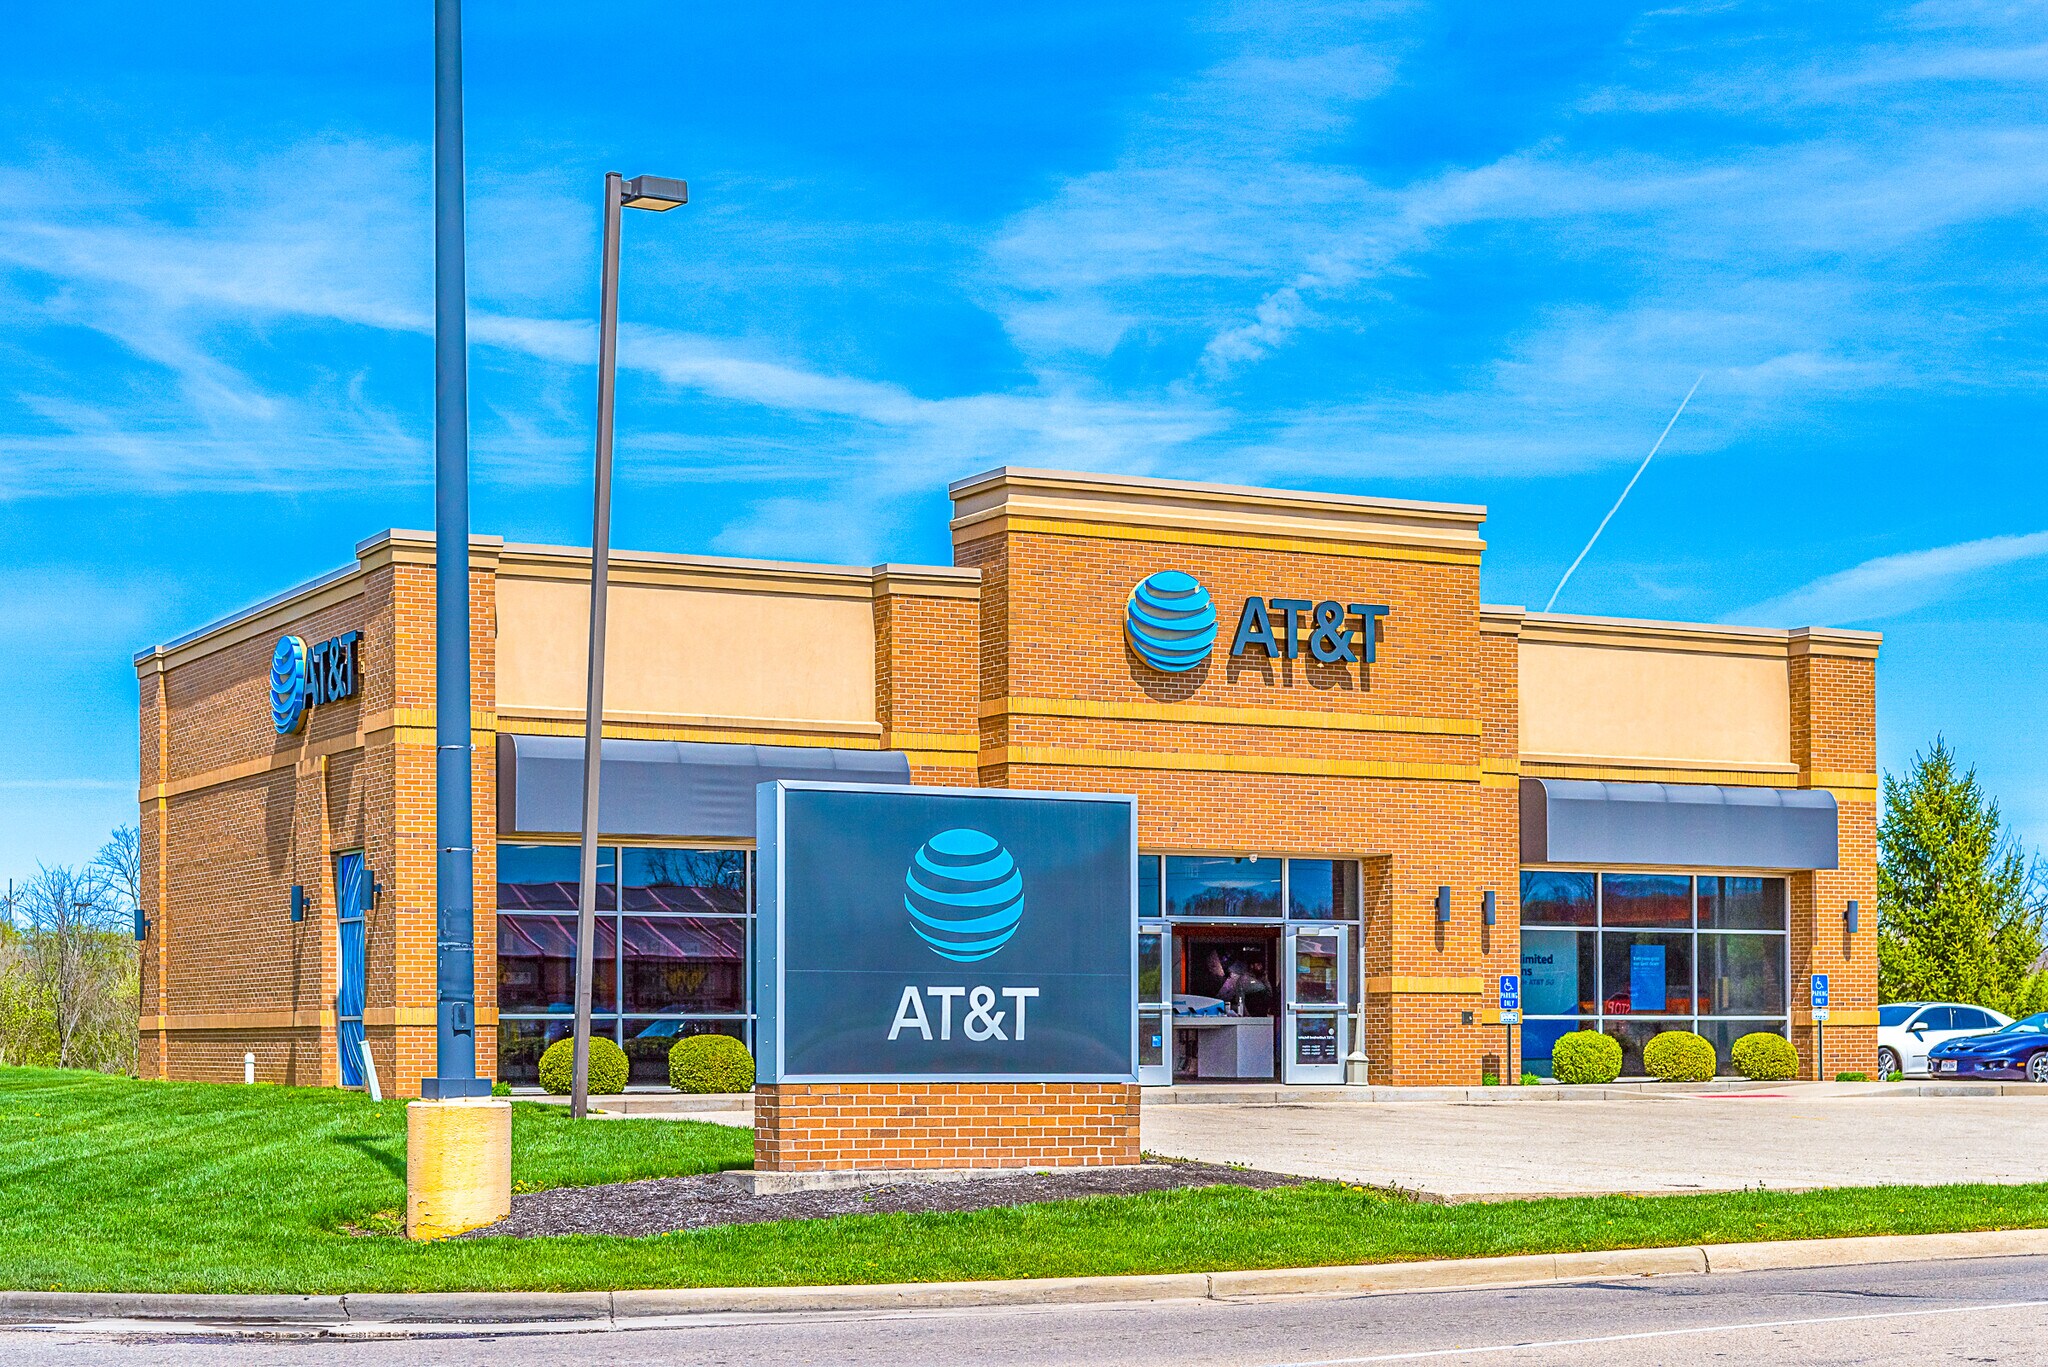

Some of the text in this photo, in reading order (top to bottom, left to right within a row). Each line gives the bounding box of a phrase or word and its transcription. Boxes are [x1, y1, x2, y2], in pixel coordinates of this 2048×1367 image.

[1231, 596, 1390, 664] AT&T
[303, 629, 360, 710] AT&T
[887, 985, 1040, 1042] AT&T
[1504, 999, 1515, 1007] ONLY
